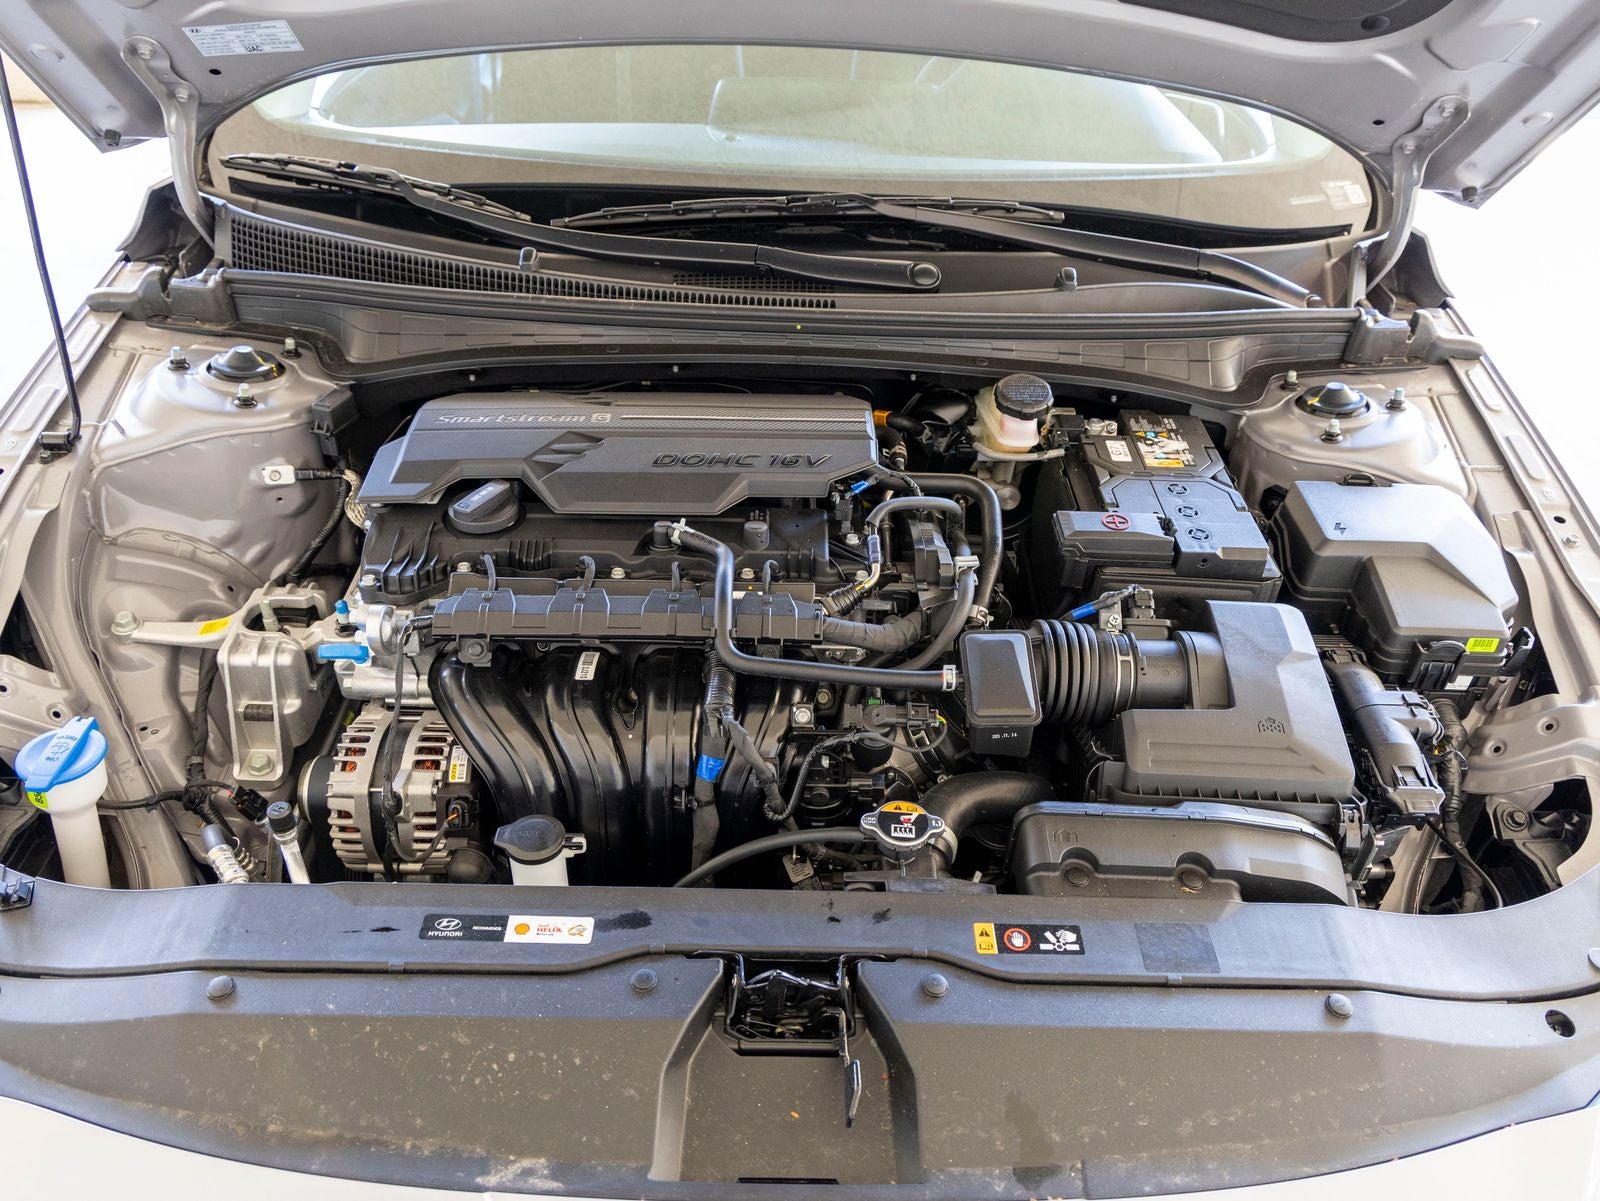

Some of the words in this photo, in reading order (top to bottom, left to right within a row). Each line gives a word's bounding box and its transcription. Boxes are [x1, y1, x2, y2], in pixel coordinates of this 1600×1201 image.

[245, 45, 263, 53] UAC
[435, 413, 586, 424] Smartstream
[651, 451, 761, 468] DOHC
[767, 452, 832, 468] 16V
